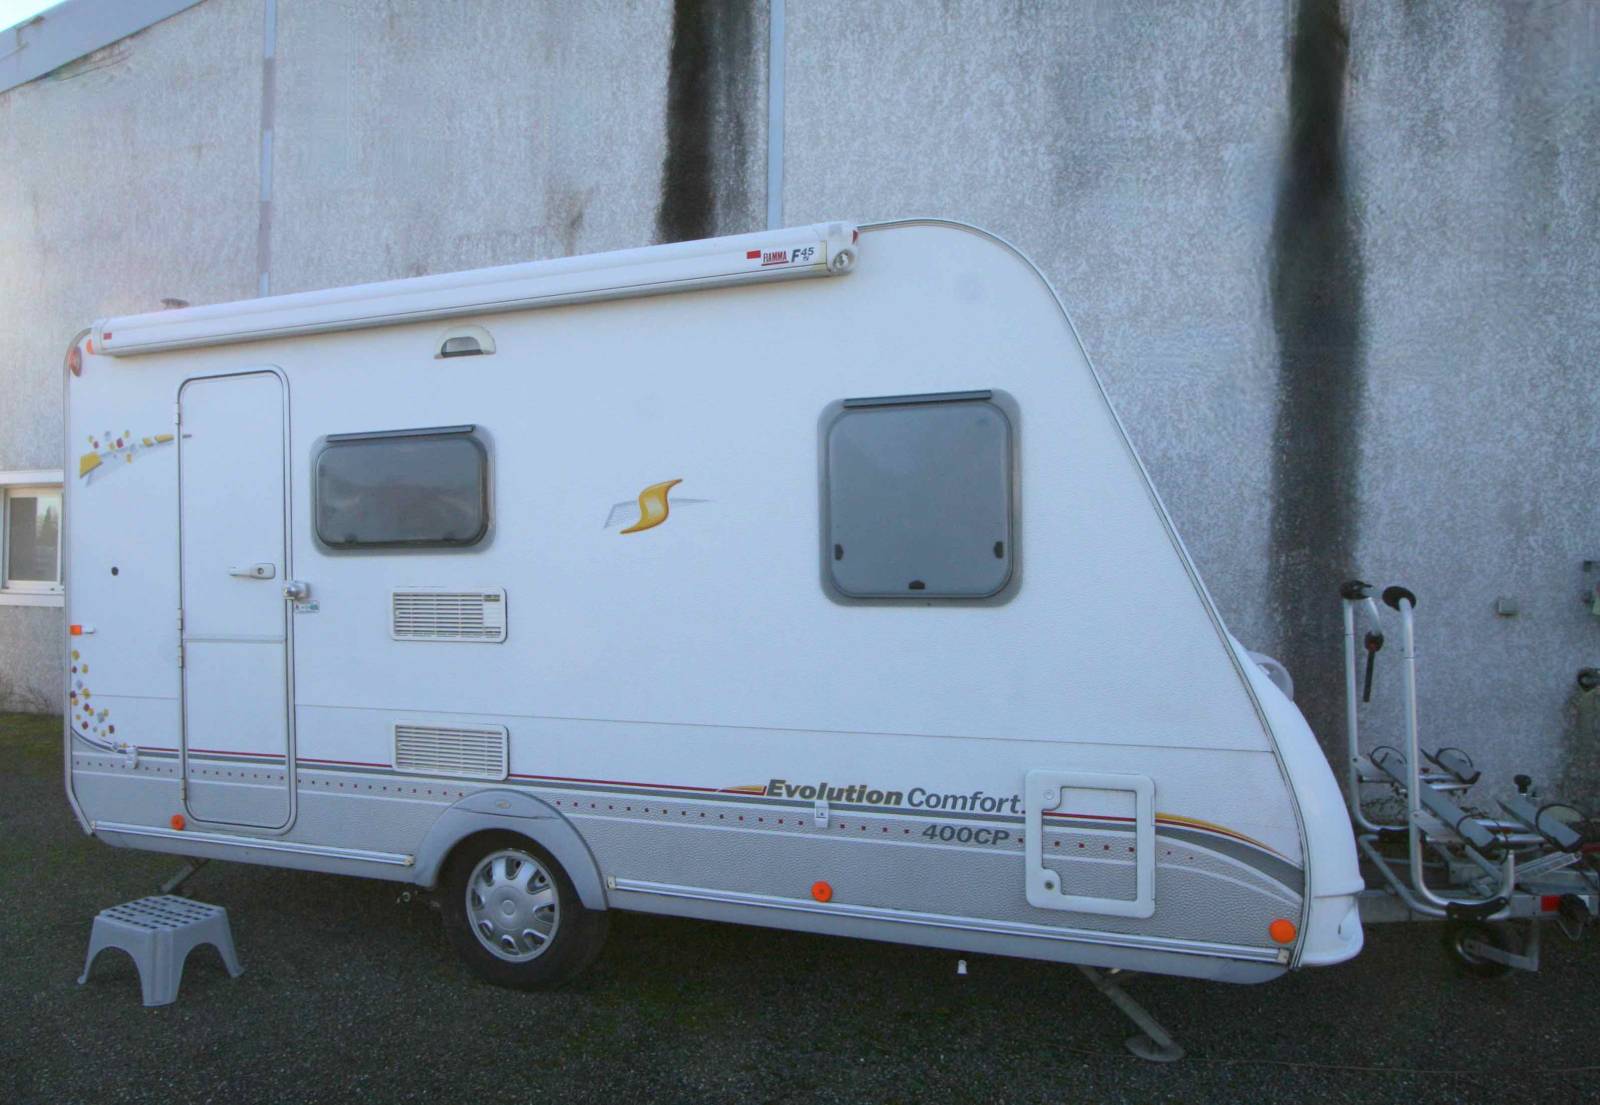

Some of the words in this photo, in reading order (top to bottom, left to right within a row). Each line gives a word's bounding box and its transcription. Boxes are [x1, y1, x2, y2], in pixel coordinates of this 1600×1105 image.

[763, 250, 787, 263] FIAMMA
[791, 246, 815, 262] F45
[767, 779, 904, 806] Evolution
[922, 824, 1010, 845] 400CP
